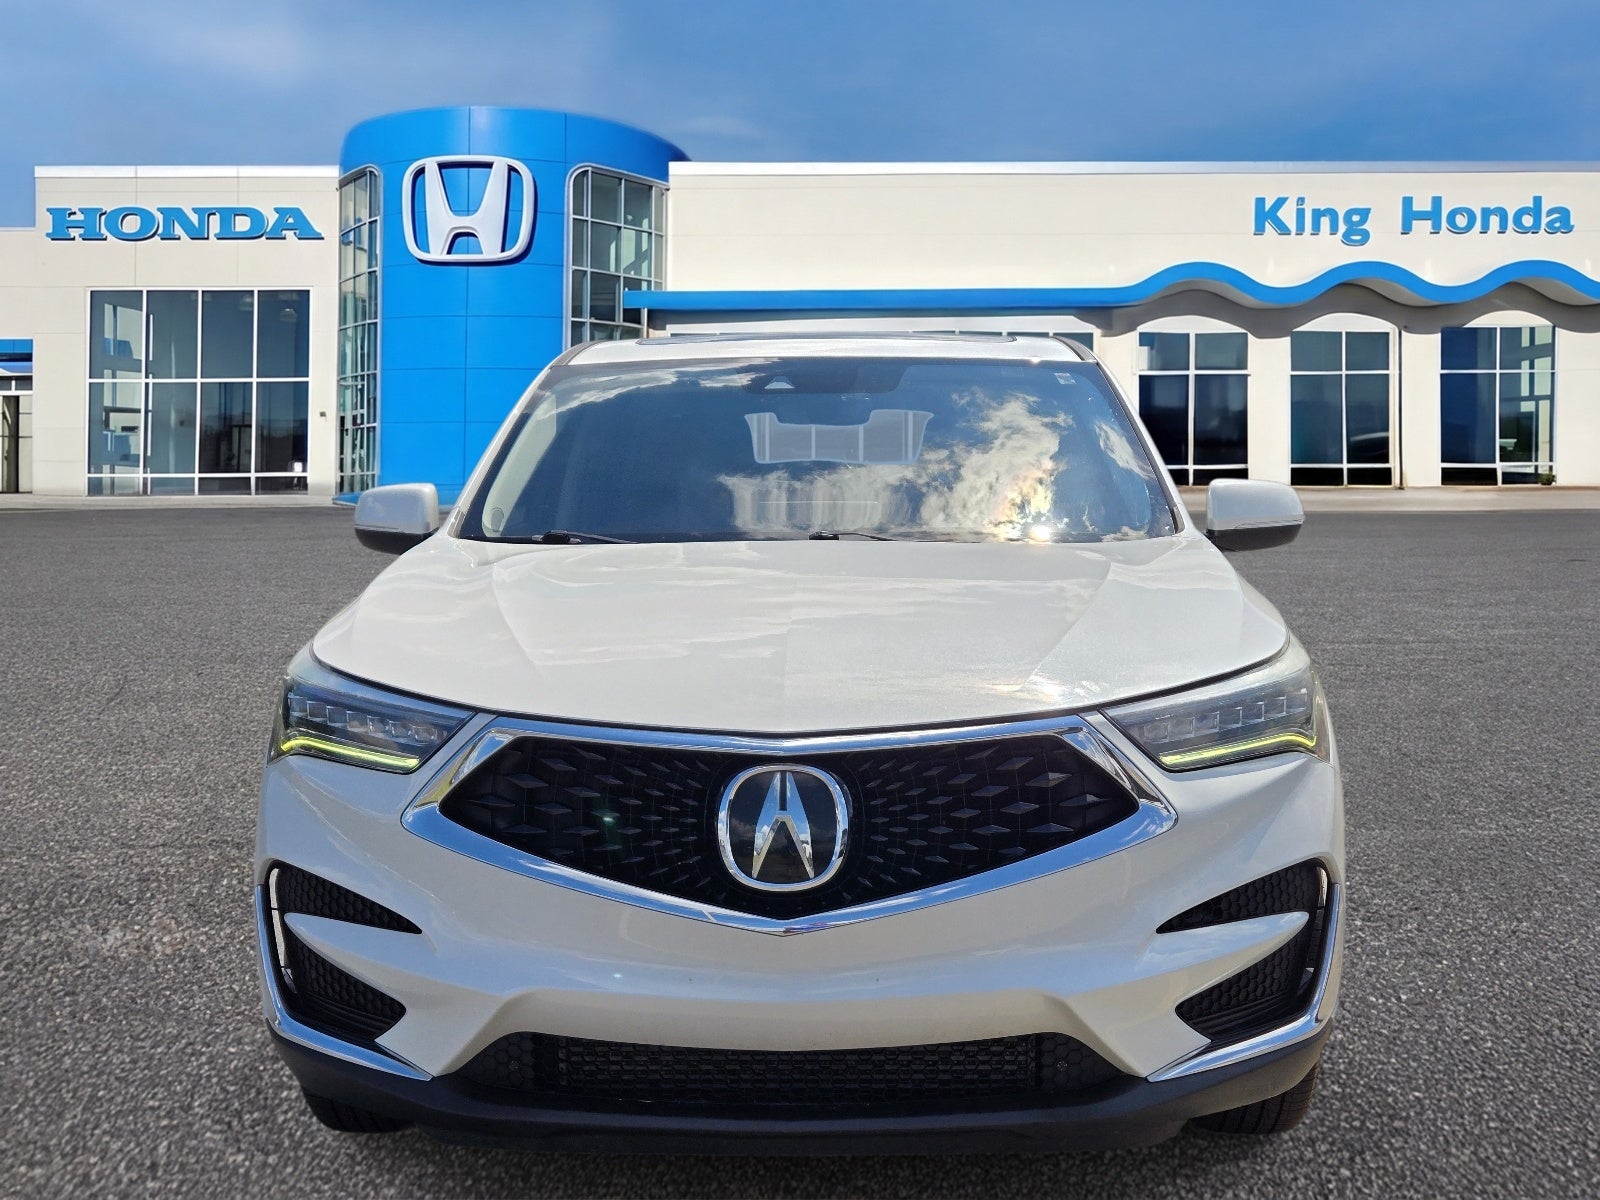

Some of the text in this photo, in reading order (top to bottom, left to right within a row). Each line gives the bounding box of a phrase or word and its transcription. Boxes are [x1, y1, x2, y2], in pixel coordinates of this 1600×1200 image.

[45, 206, 325, 241] HONDA
[1253, 195, 1575, 246] King Honda
